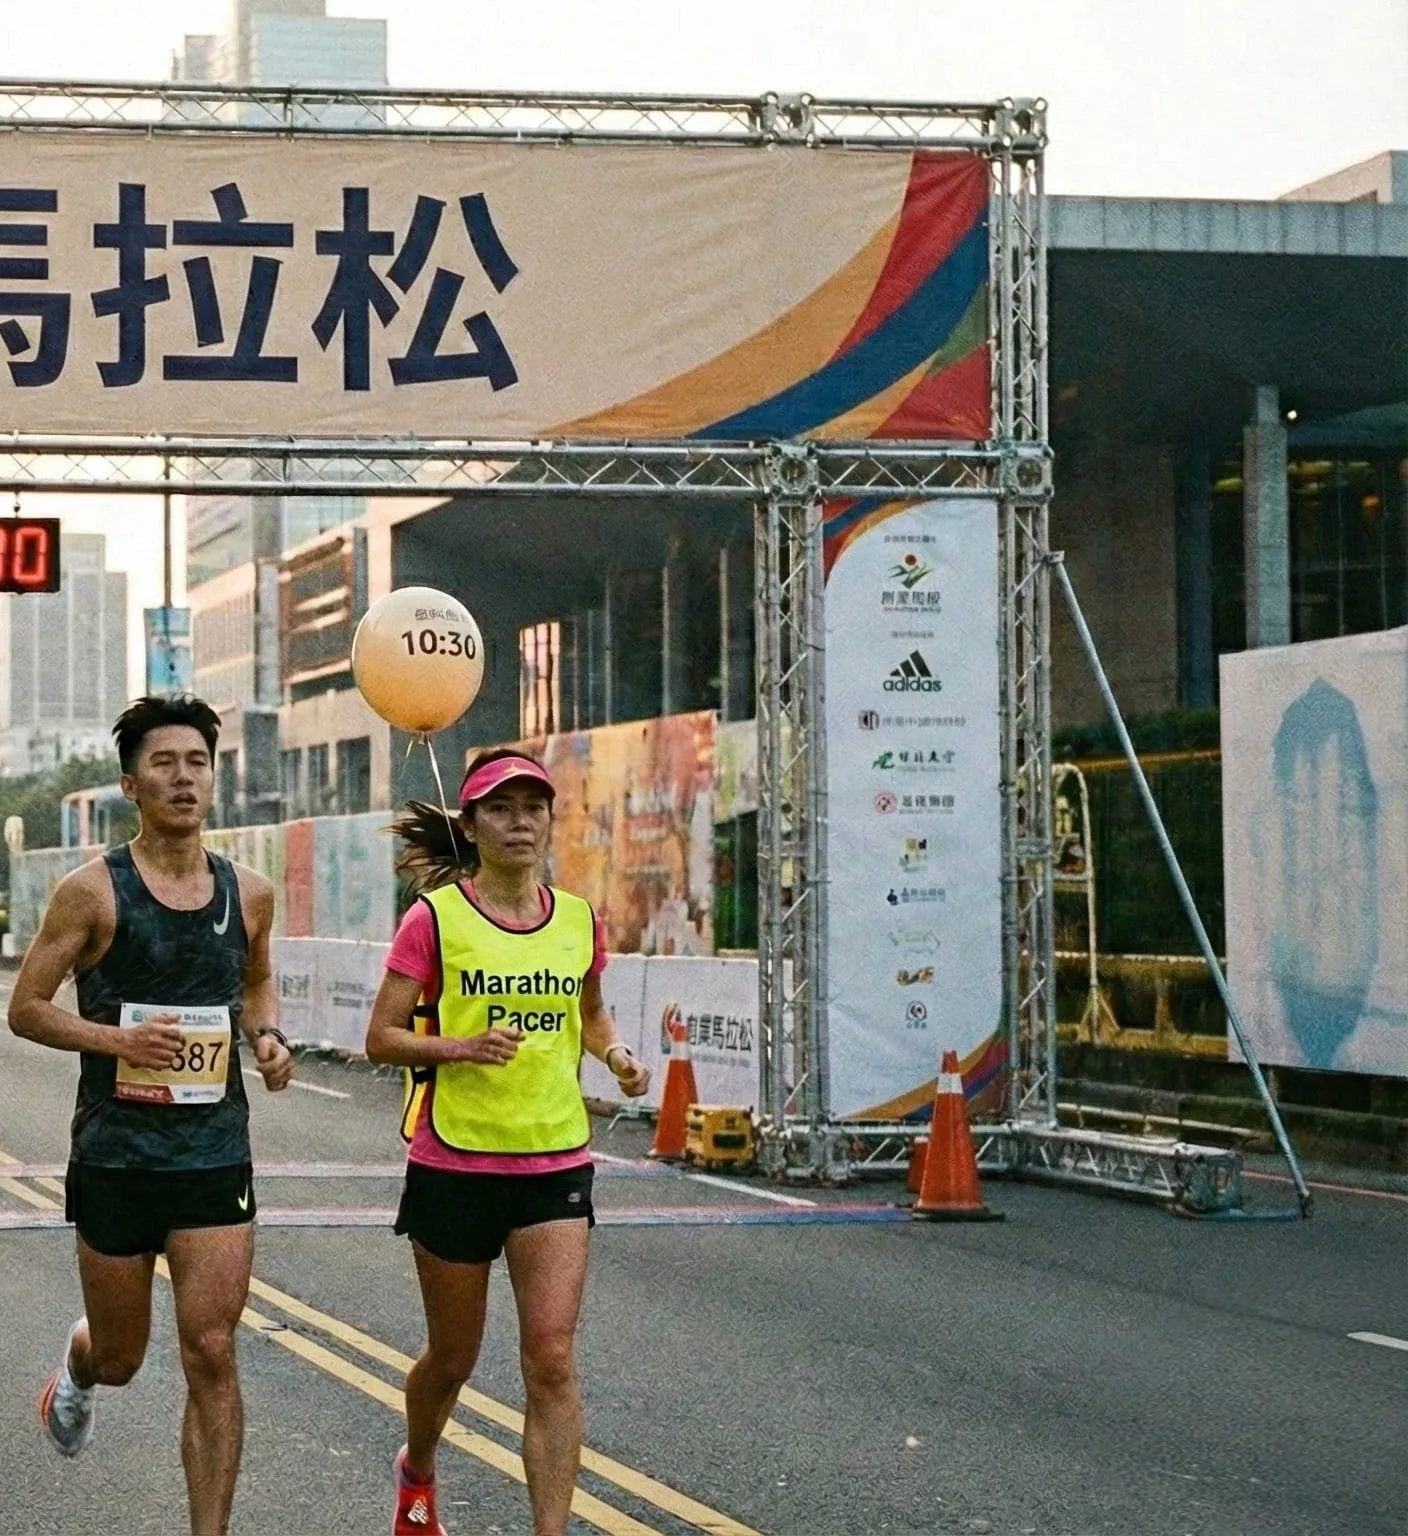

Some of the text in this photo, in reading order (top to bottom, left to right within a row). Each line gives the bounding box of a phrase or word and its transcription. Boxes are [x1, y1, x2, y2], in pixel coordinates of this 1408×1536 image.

[401, 628, 477, 660] 10:30
[883, 676, 942, 692] adidas
[487, 1005, 567, 1032] Pacer
